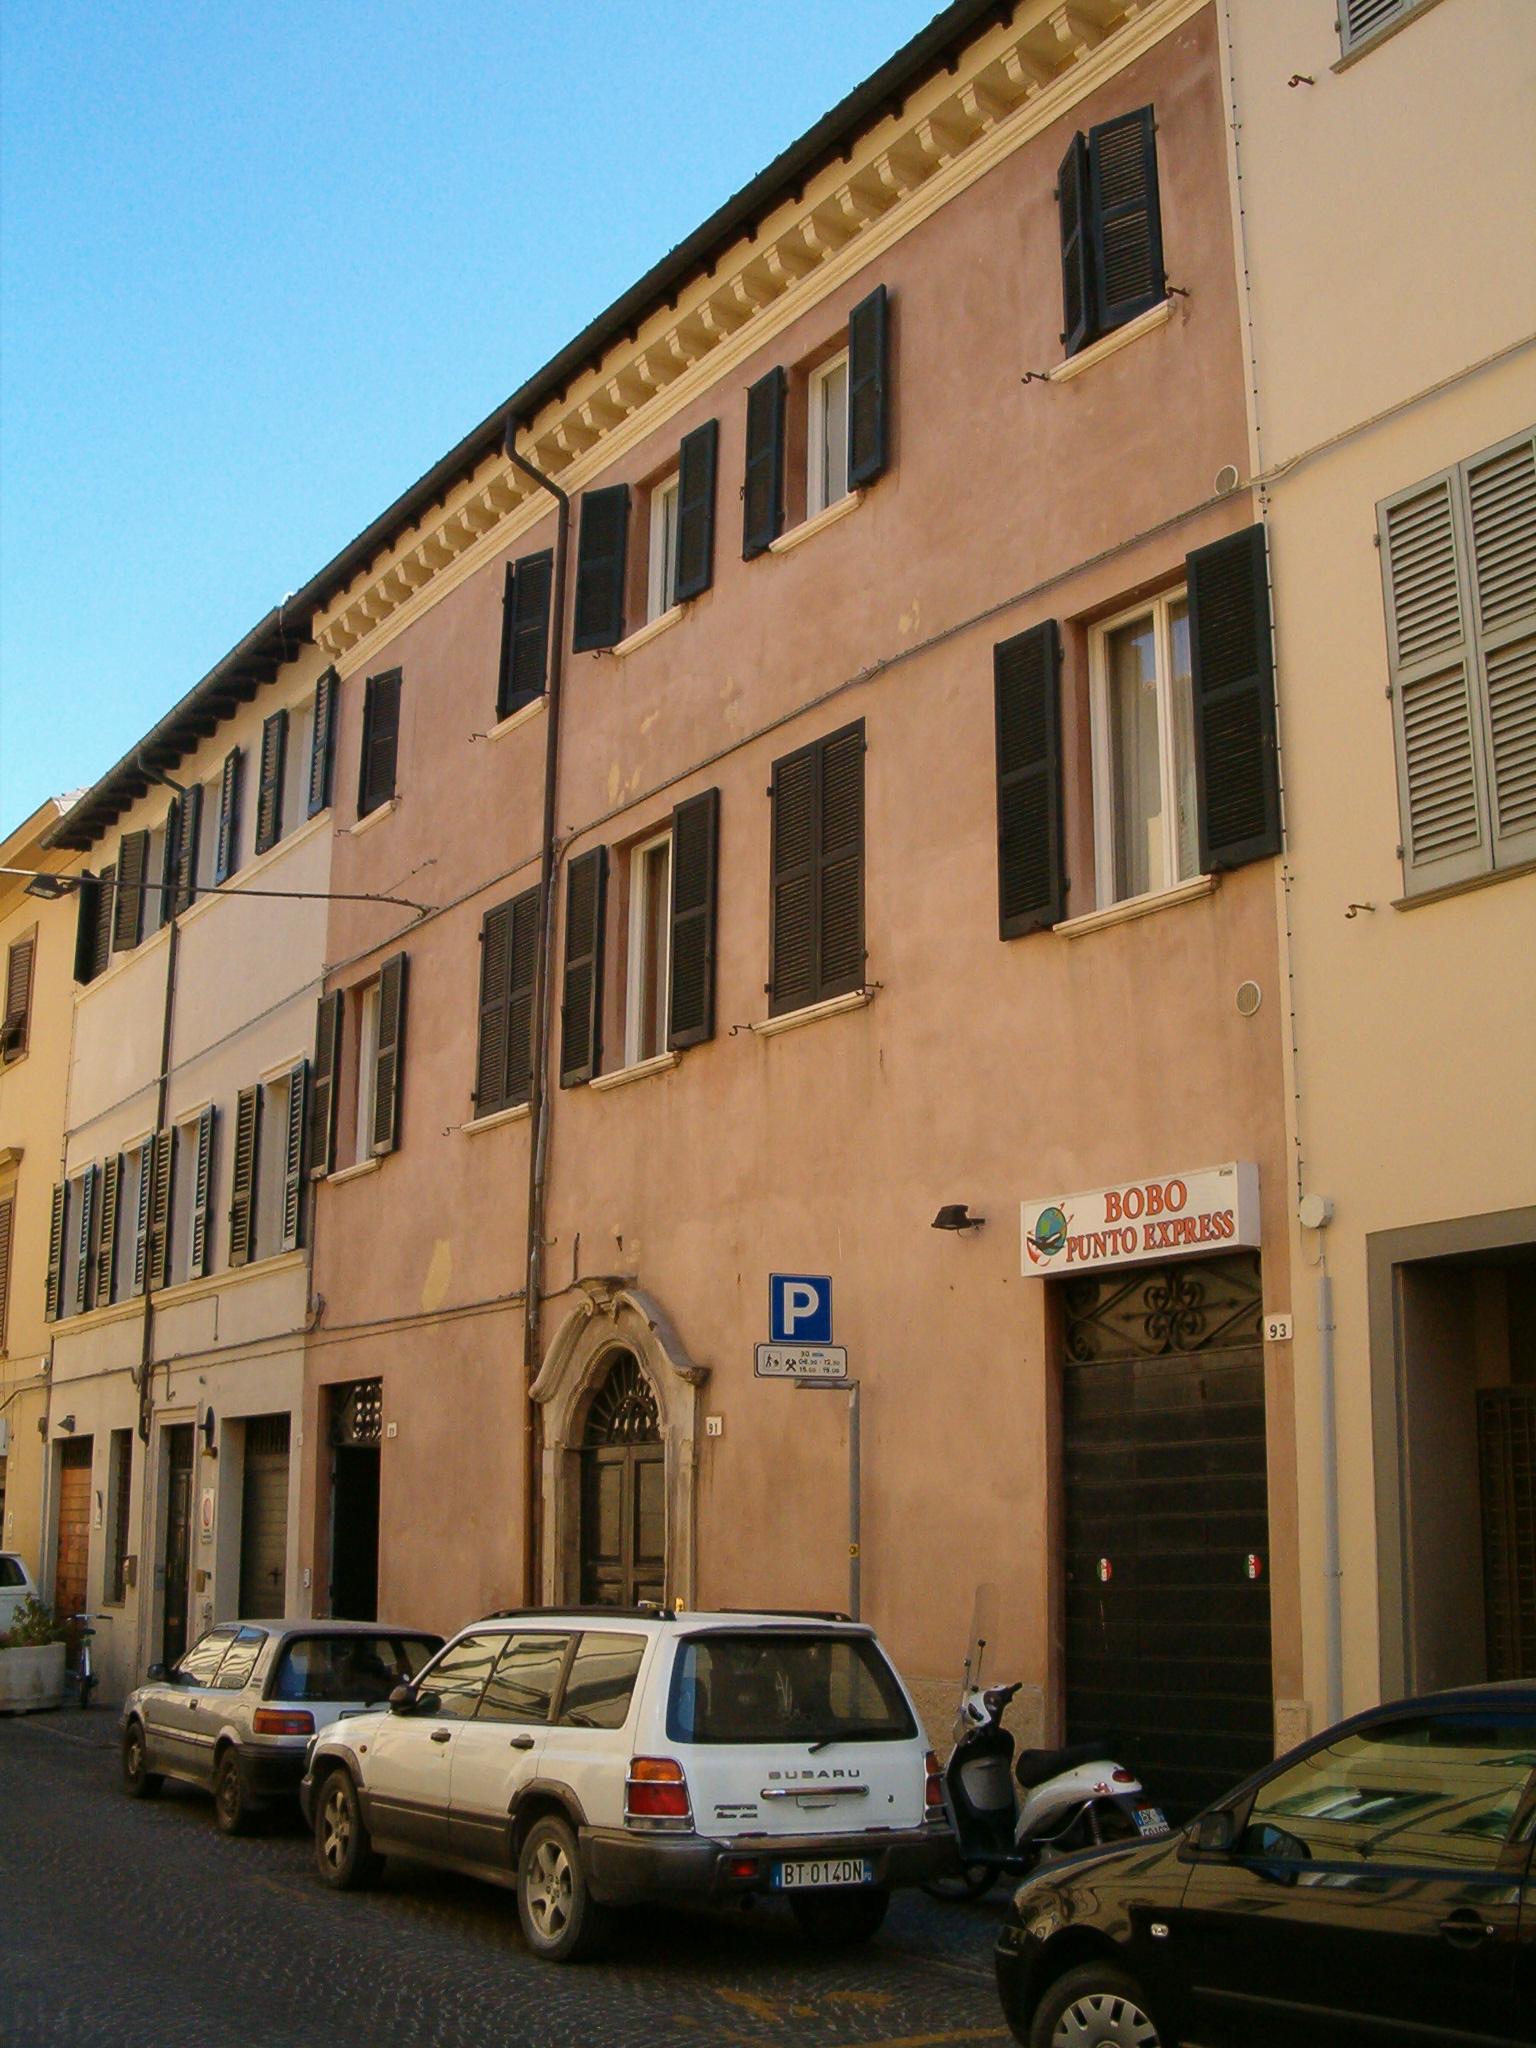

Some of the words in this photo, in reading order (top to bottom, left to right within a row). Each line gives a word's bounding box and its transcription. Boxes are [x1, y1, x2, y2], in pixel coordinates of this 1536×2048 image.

[1104, 1179, 1188, 1224] BOBO
[1066, 1225, 1138, 1263] PUNTO
[1143, 1209, 1235, 1251] EXPRESS
[783, 1282, 820, 1335] P
[1269, 1323, 1287, 1339] 93
[768, 1769, 861, 1780] SUBARU
